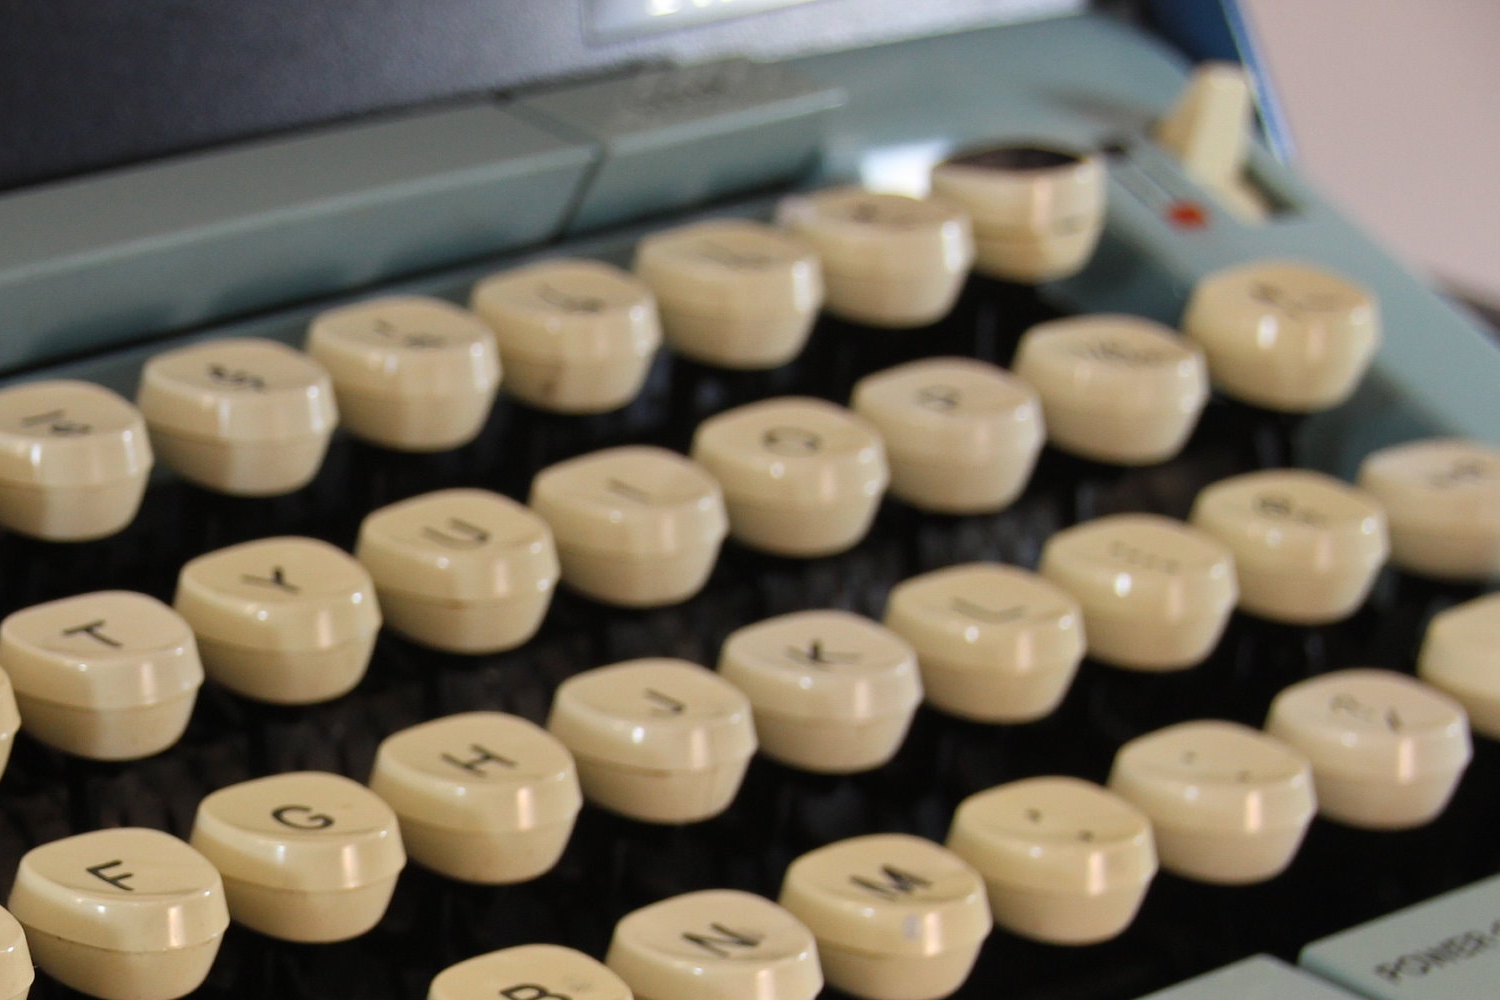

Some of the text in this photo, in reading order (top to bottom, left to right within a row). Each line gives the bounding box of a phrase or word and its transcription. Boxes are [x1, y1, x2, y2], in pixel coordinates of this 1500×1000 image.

[421, 516, 490, 548] U
[240, 565, 303, 594] Y
[63, 619, 123, 649] T
[785, 640, 863, 671] K
[645, 687, 687, 716] J
[441, 743, 517, 778] H
[271, 804, 336, 832] G
[85, 859, 136, 892] F
[850, 864, 932, 899] M
[682, 922, 762, 958] N
